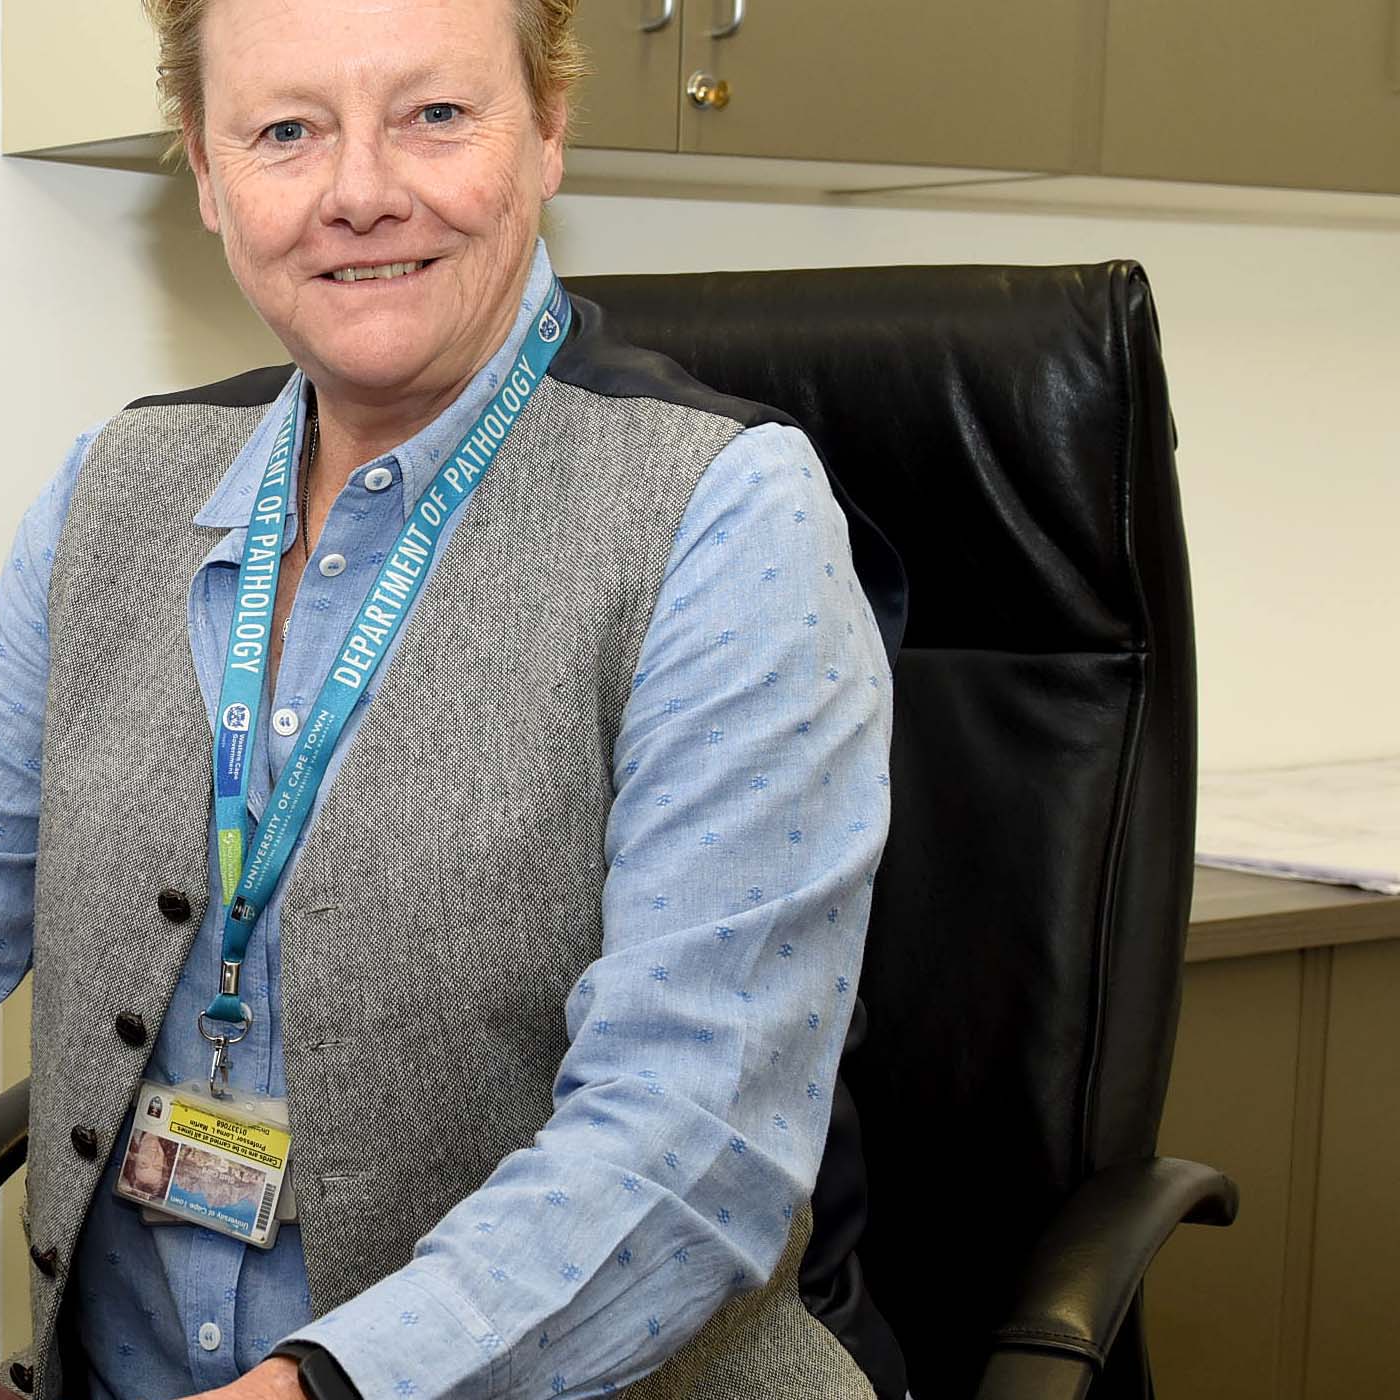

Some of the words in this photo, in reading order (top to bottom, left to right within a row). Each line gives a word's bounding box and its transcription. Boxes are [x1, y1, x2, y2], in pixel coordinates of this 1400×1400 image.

[255, 495, 282, 525] OF
[332, 522, 432, 689] DEPARTMENT
[420, 486, 448, 527] OF
[443, 354, 537, 494] PATHOLOGY
[230, 532, 278, 673] PATHOLOGY
[236, 733, 245, 761] Western
[228, 734, 239, 775] Government
[244, 815, 281, 889] UNIVERSITY
[278, 792, 290, 810] OF
[288, 755, 308, 787] CAPE
[304, 710, 329, 750] TOWN
[177, 1126, 193, 1137] times
[189, 1119, 208, 1132] Martin
[217, 1129, 234, 1138] Lorna
[209, 1137, 231, 1149] carried
[231, 1144, 239, 1152] be
[236, 1135, 267, 1151] Professor
[259, 1155, 278, 1166] Cards
[170, 1195, 187, 1208] Town
[189, 1203, 208, 1215] Cape
[208, 1209, 215, 1217] of
[216, 1211, 249, 1230] University
